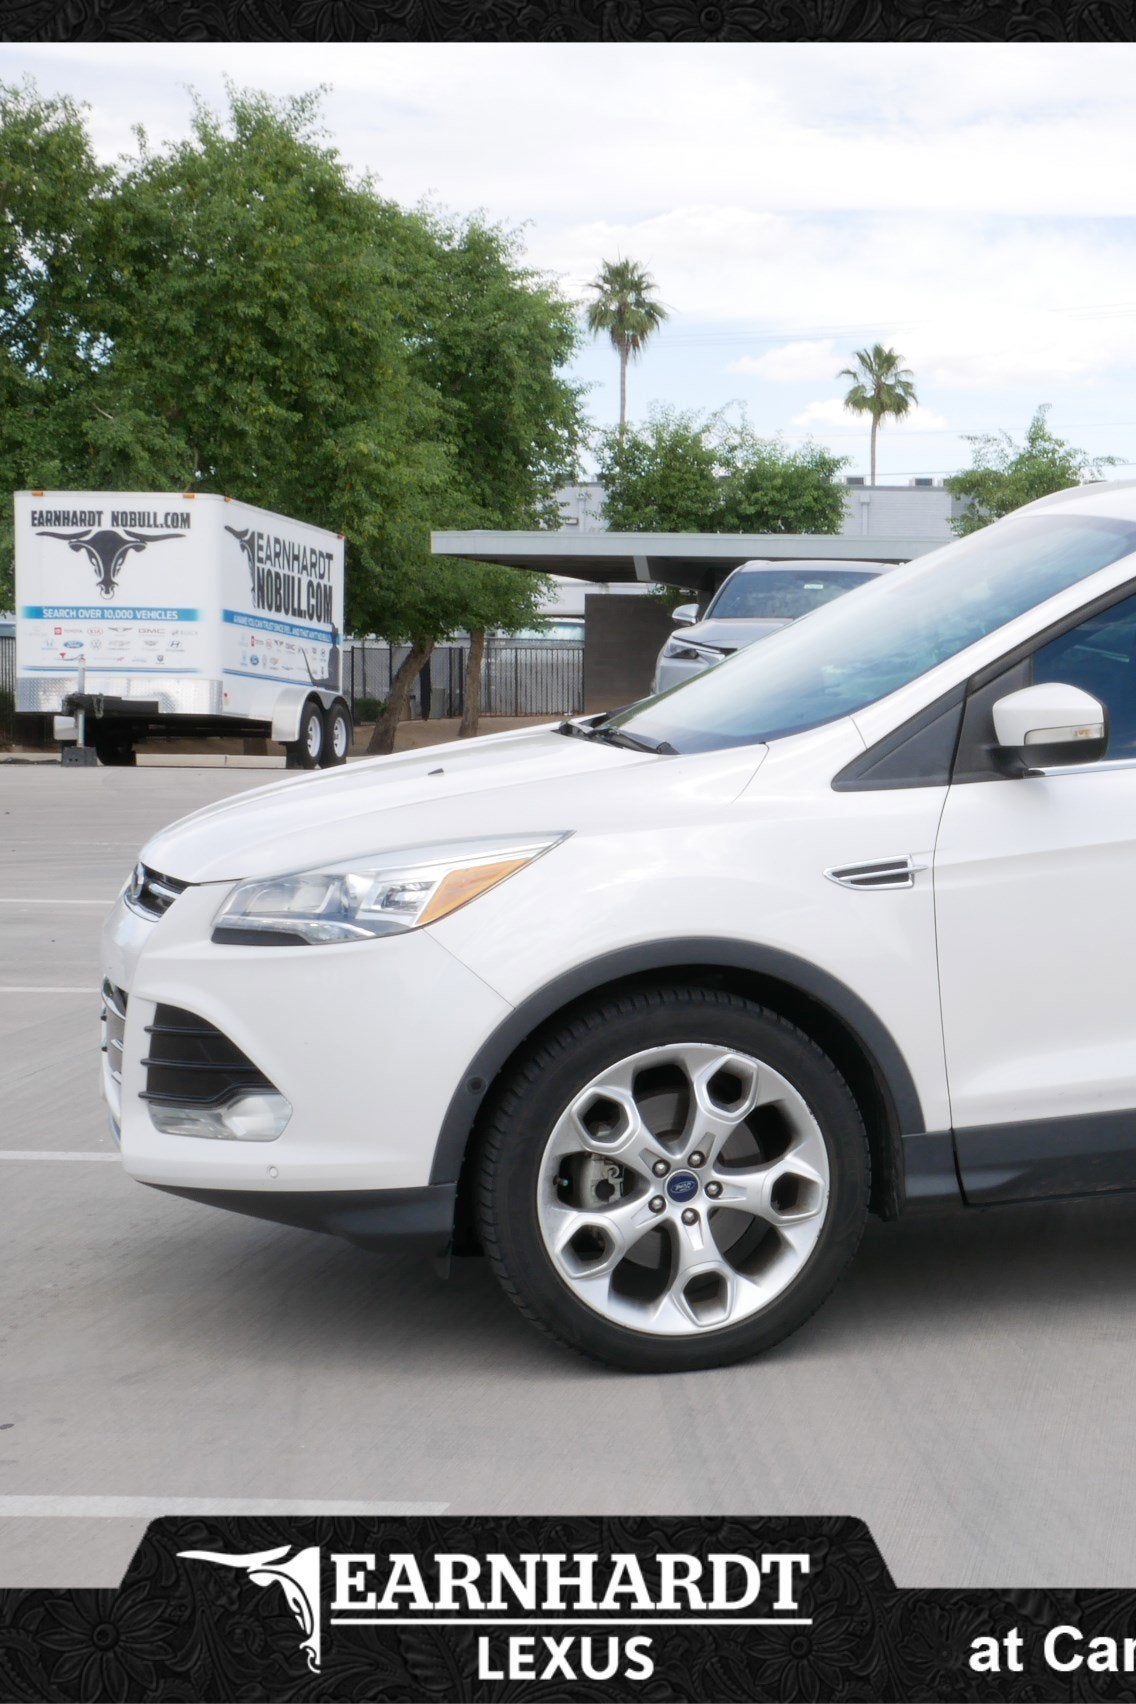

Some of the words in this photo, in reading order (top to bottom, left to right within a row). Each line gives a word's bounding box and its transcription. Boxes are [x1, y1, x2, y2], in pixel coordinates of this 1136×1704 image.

[31, 510, 103, 527] EARNHARDT
[111, 511, 191, 529] NOBULL.COM
[256, 530, 334, 583] EARNHARDT
[256, 565, 333, 625] NOBULL.COM
[42, 608, 76, 618] SEARCH
[79, 609, 101, 618] OVER
[103, 609, 134, 620] 10,000
[136, 609, 178, 620] VEHICLES
